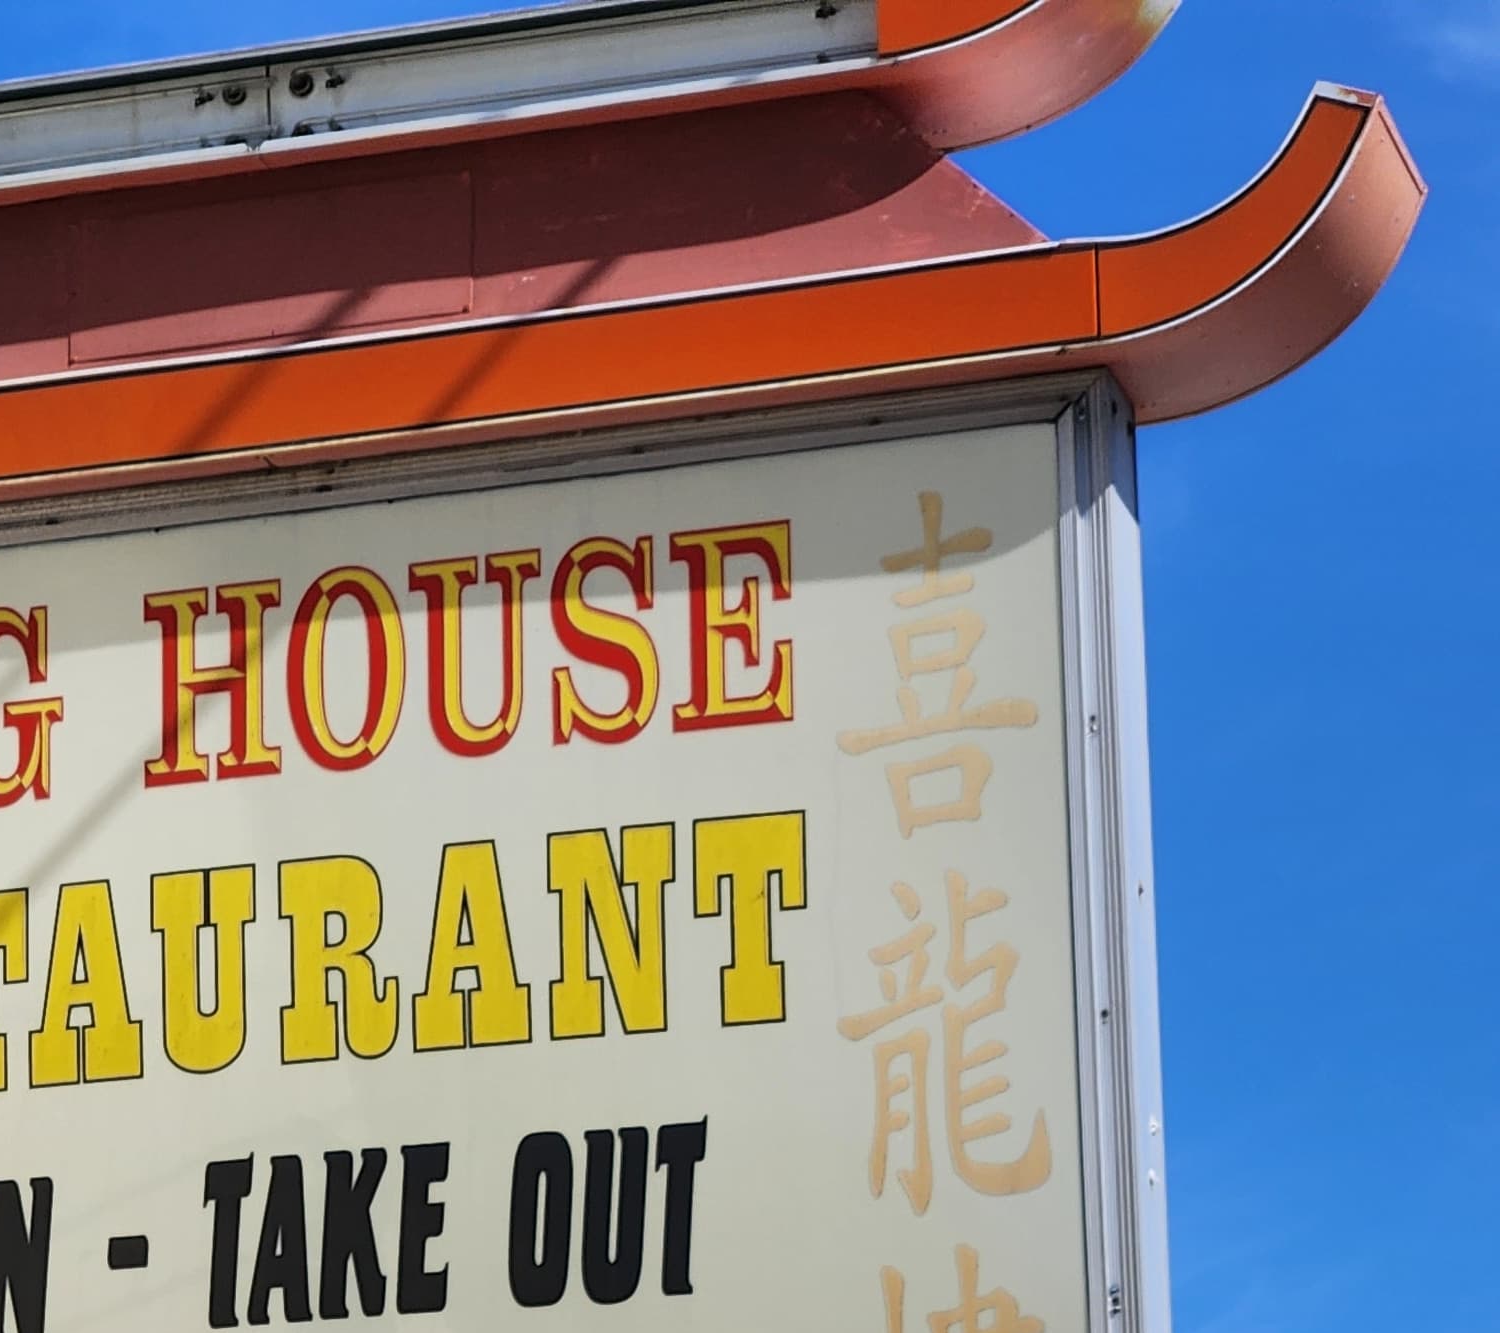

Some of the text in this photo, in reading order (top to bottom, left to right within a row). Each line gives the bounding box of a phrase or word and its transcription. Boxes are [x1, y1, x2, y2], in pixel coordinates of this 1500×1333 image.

[142, 518, 796, 789] HOUSE
[202, 1140, 452, 1330] TAKE
[507, 1114, 709, 1309] OUT
